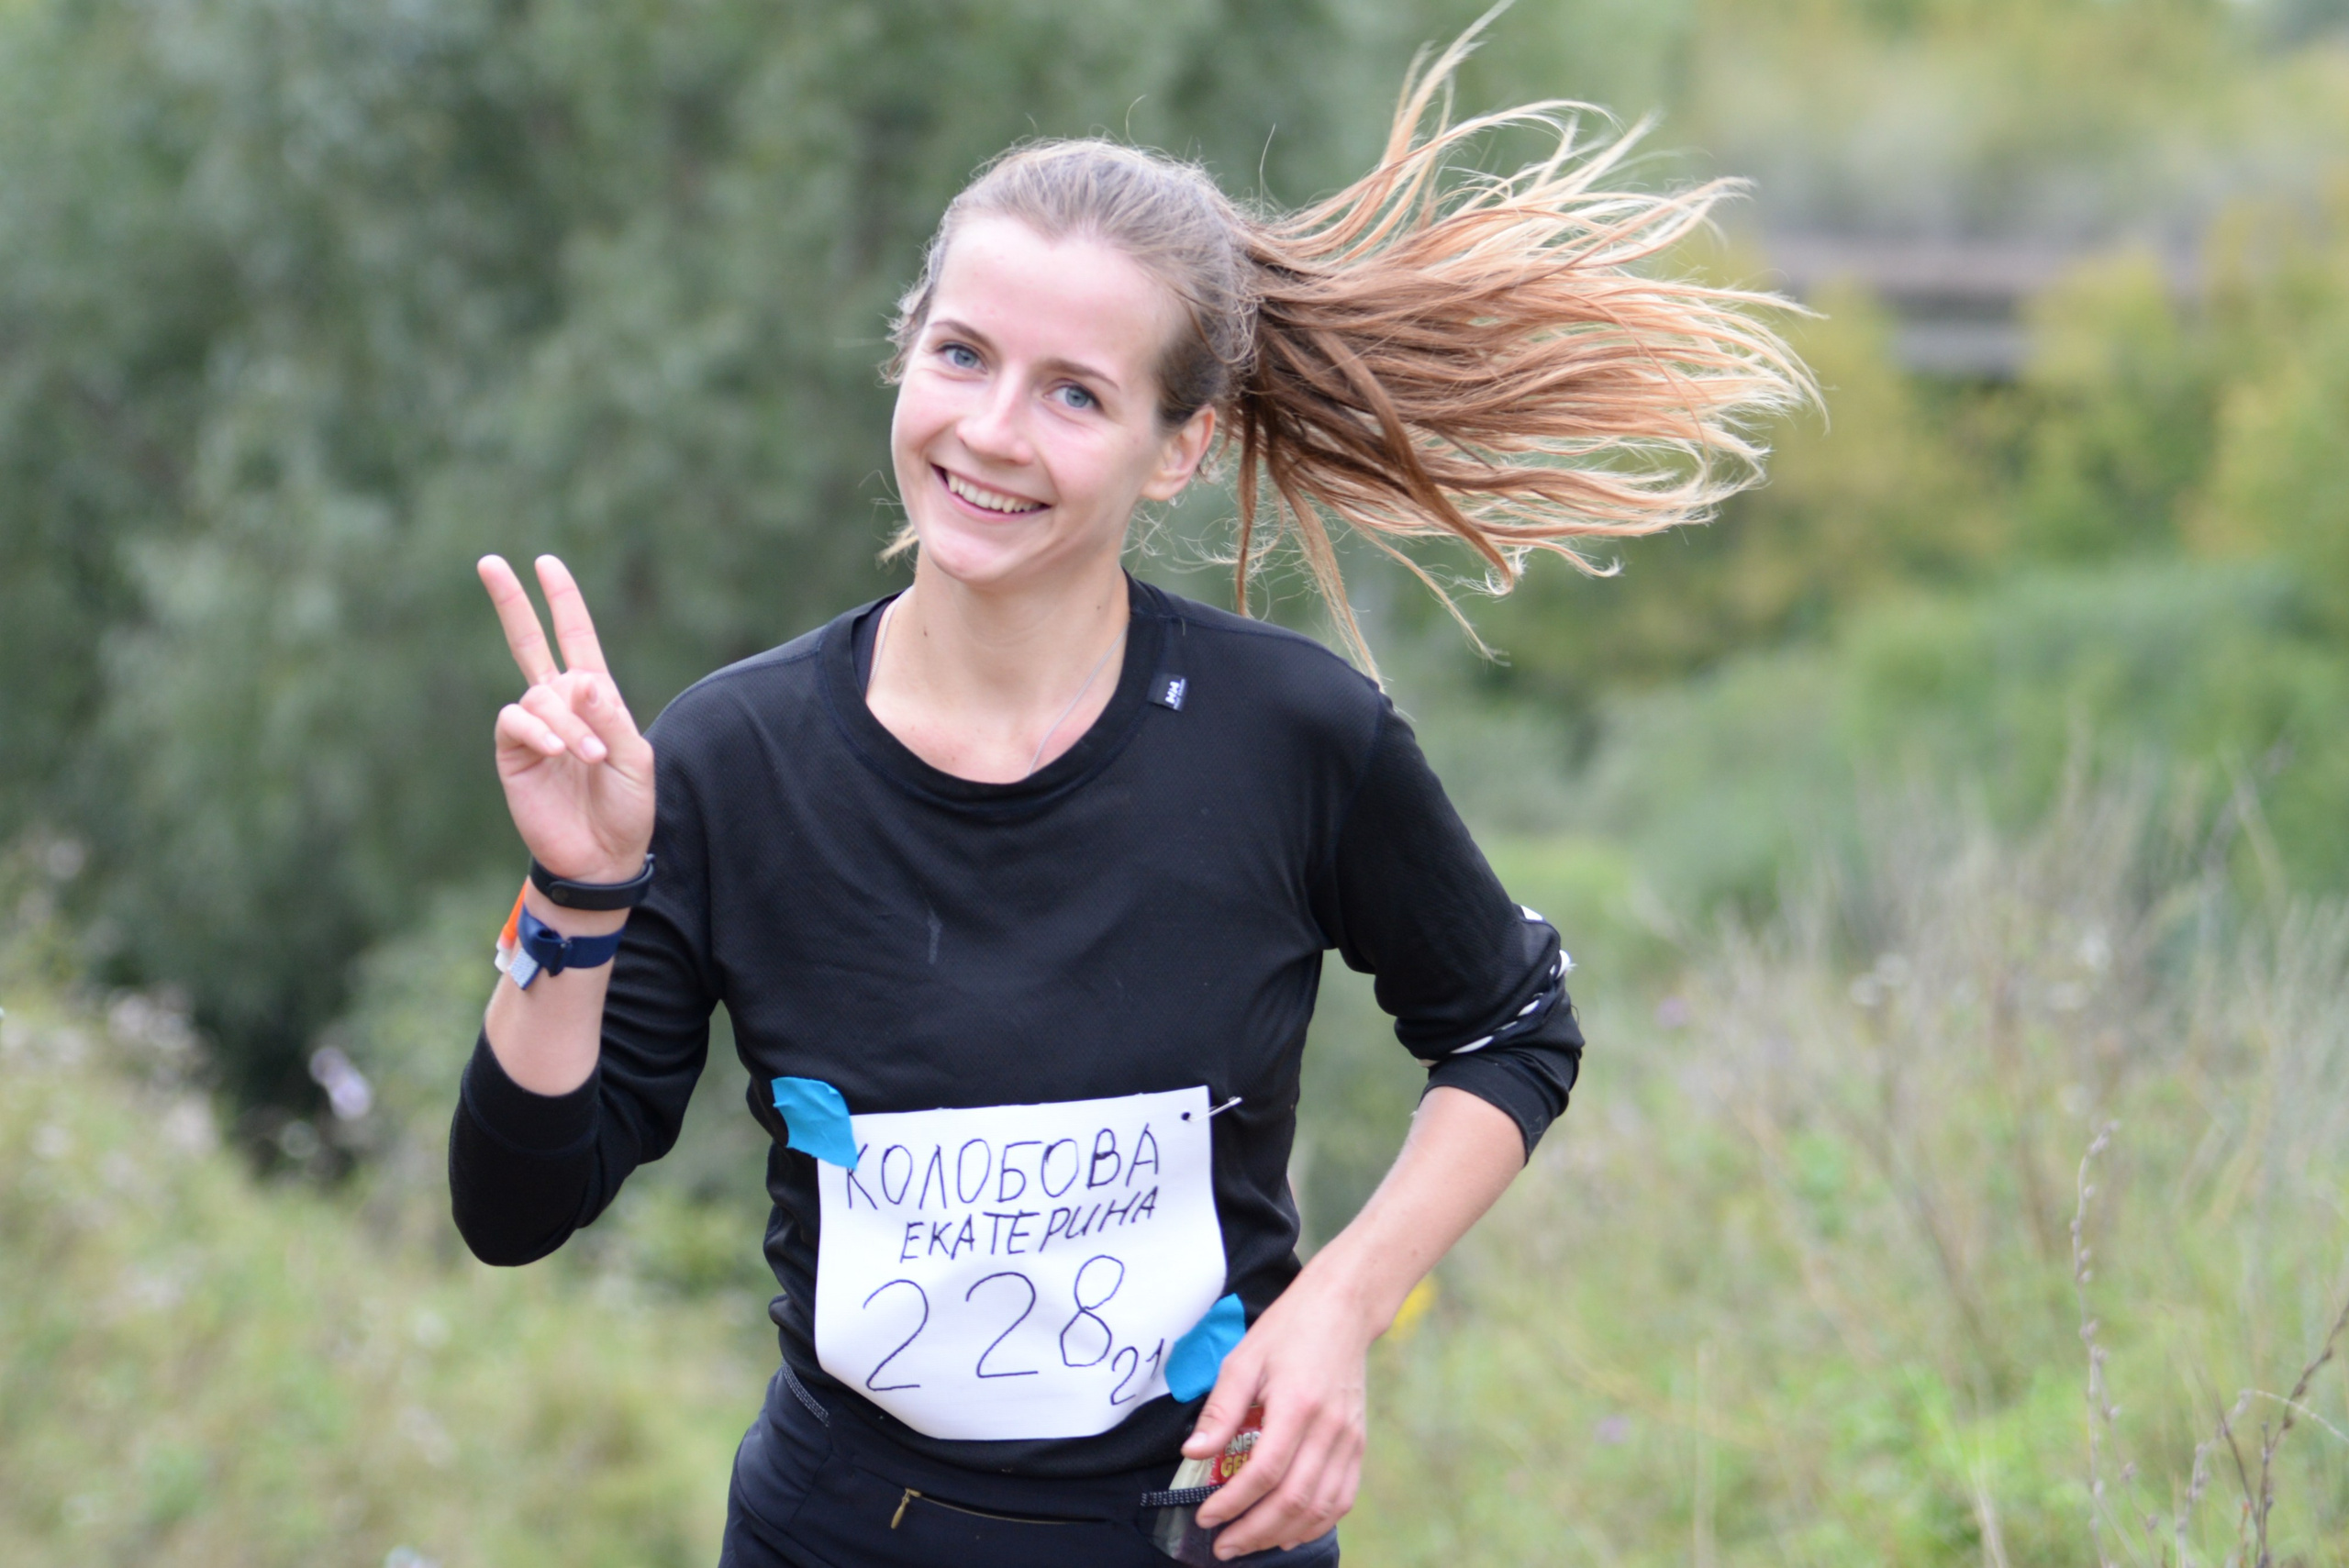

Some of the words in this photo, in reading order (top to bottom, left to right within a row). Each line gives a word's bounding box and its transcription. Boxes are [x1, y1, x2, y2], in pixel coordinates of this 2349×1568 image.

[845, 1122, 1160, 1210] КОЛОБОВА
[899, 1184, 1159, 1264] ЕКАТЕРИНА
[863, 1253, 1126, 1392] 228
[1109, 1337, 1164, 1407] 21
